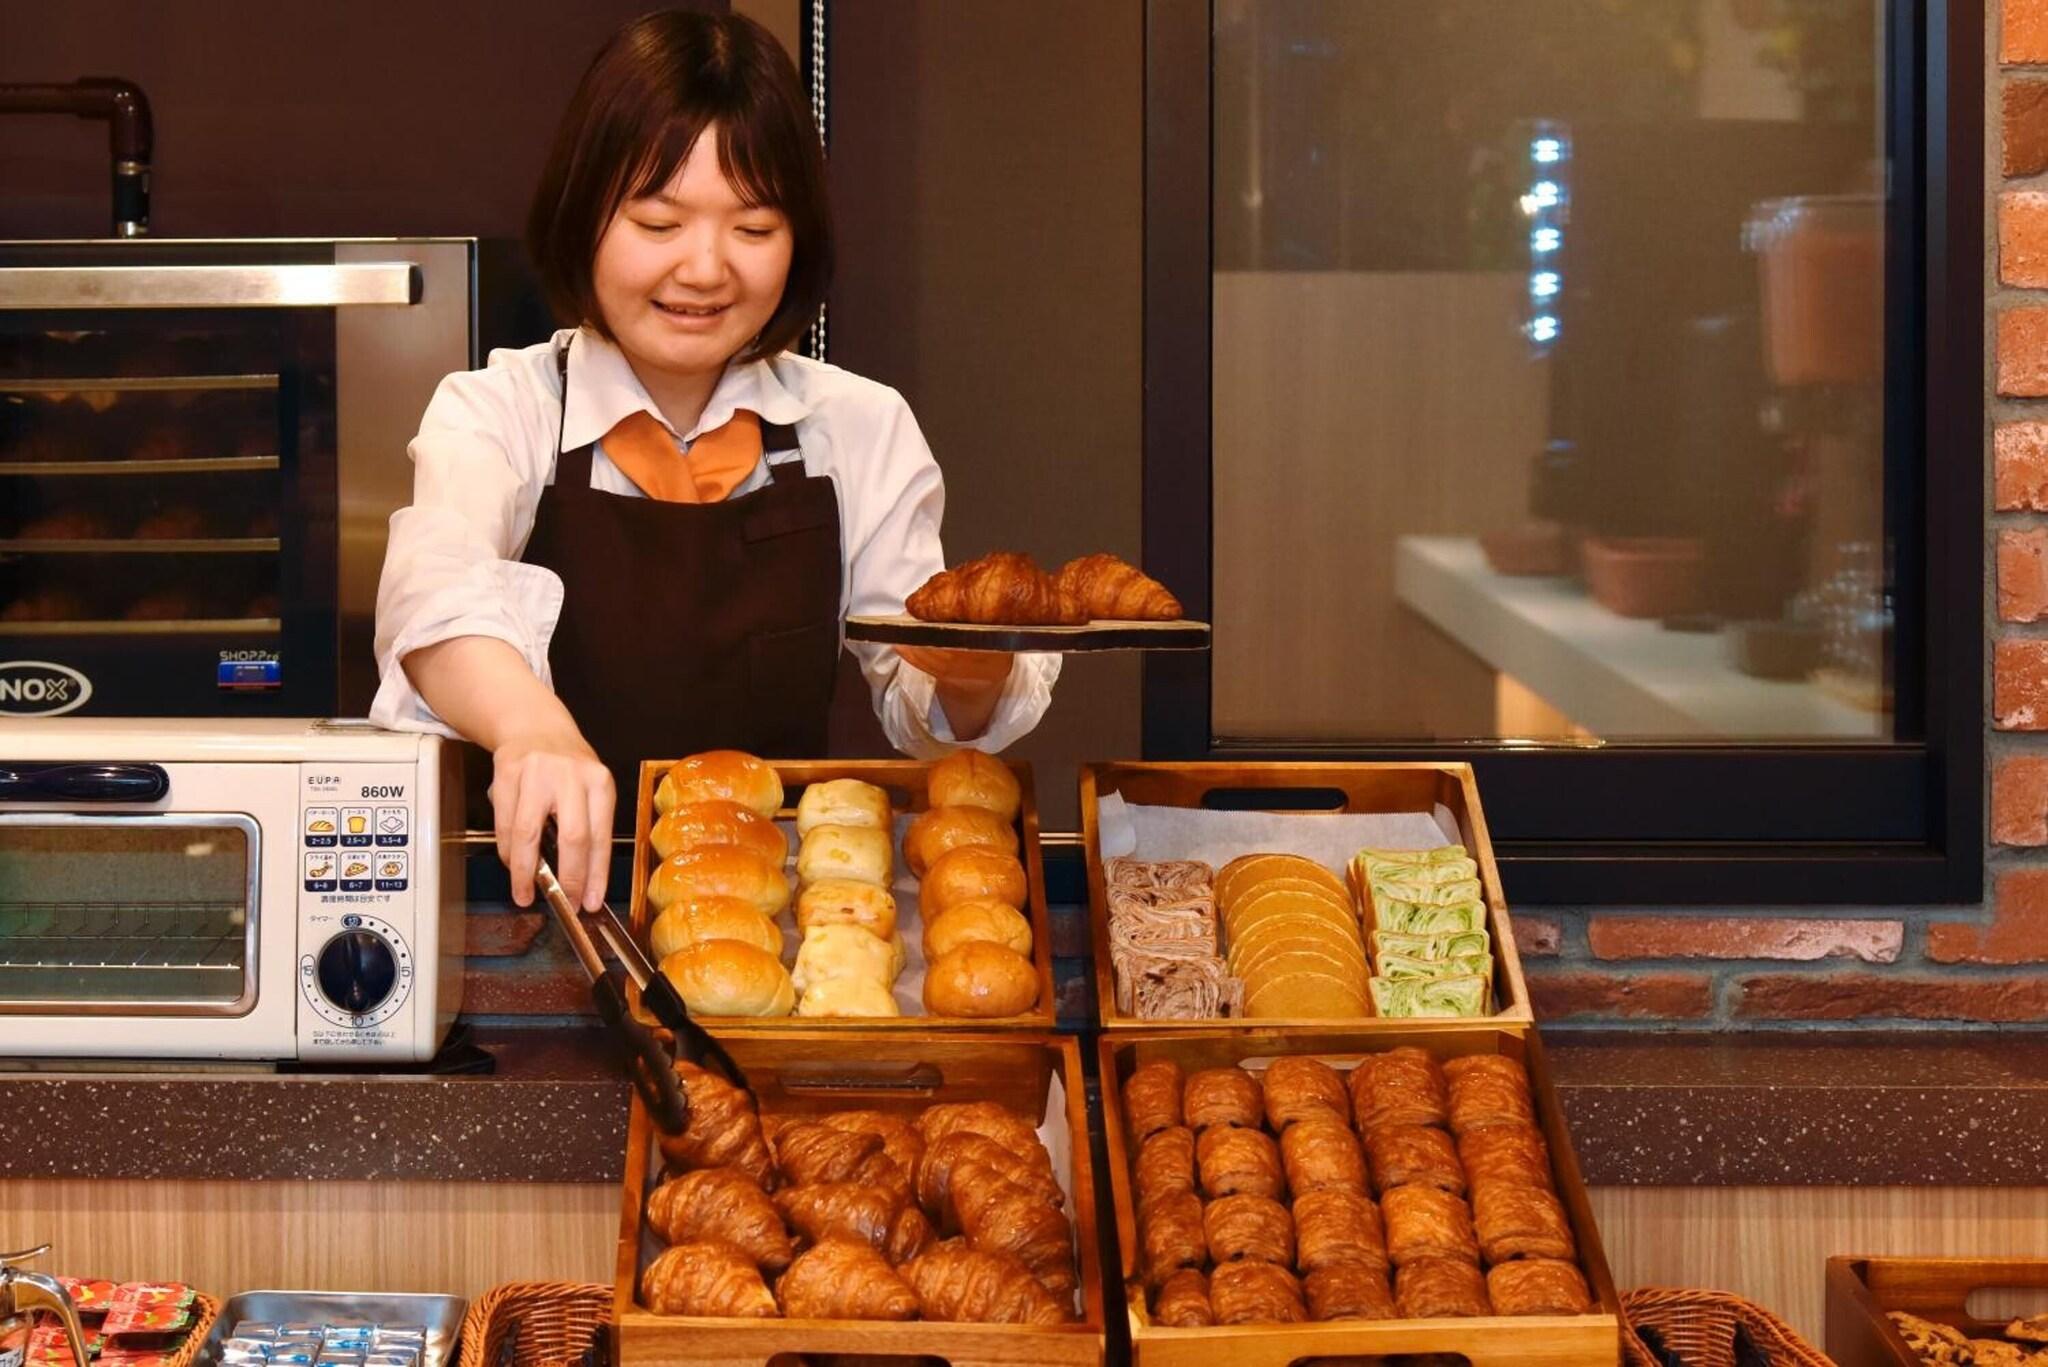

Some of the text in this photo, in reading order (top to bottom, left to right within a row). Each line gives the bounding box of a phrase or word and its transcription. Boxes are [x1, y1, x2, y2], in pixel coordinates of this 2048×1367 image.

[308, 776, 340, 785] EUPA
[361, 785, 405, 798] 860W
[400, 966, 411, 977] 5
[350, 1016, 364, 1027] 10
